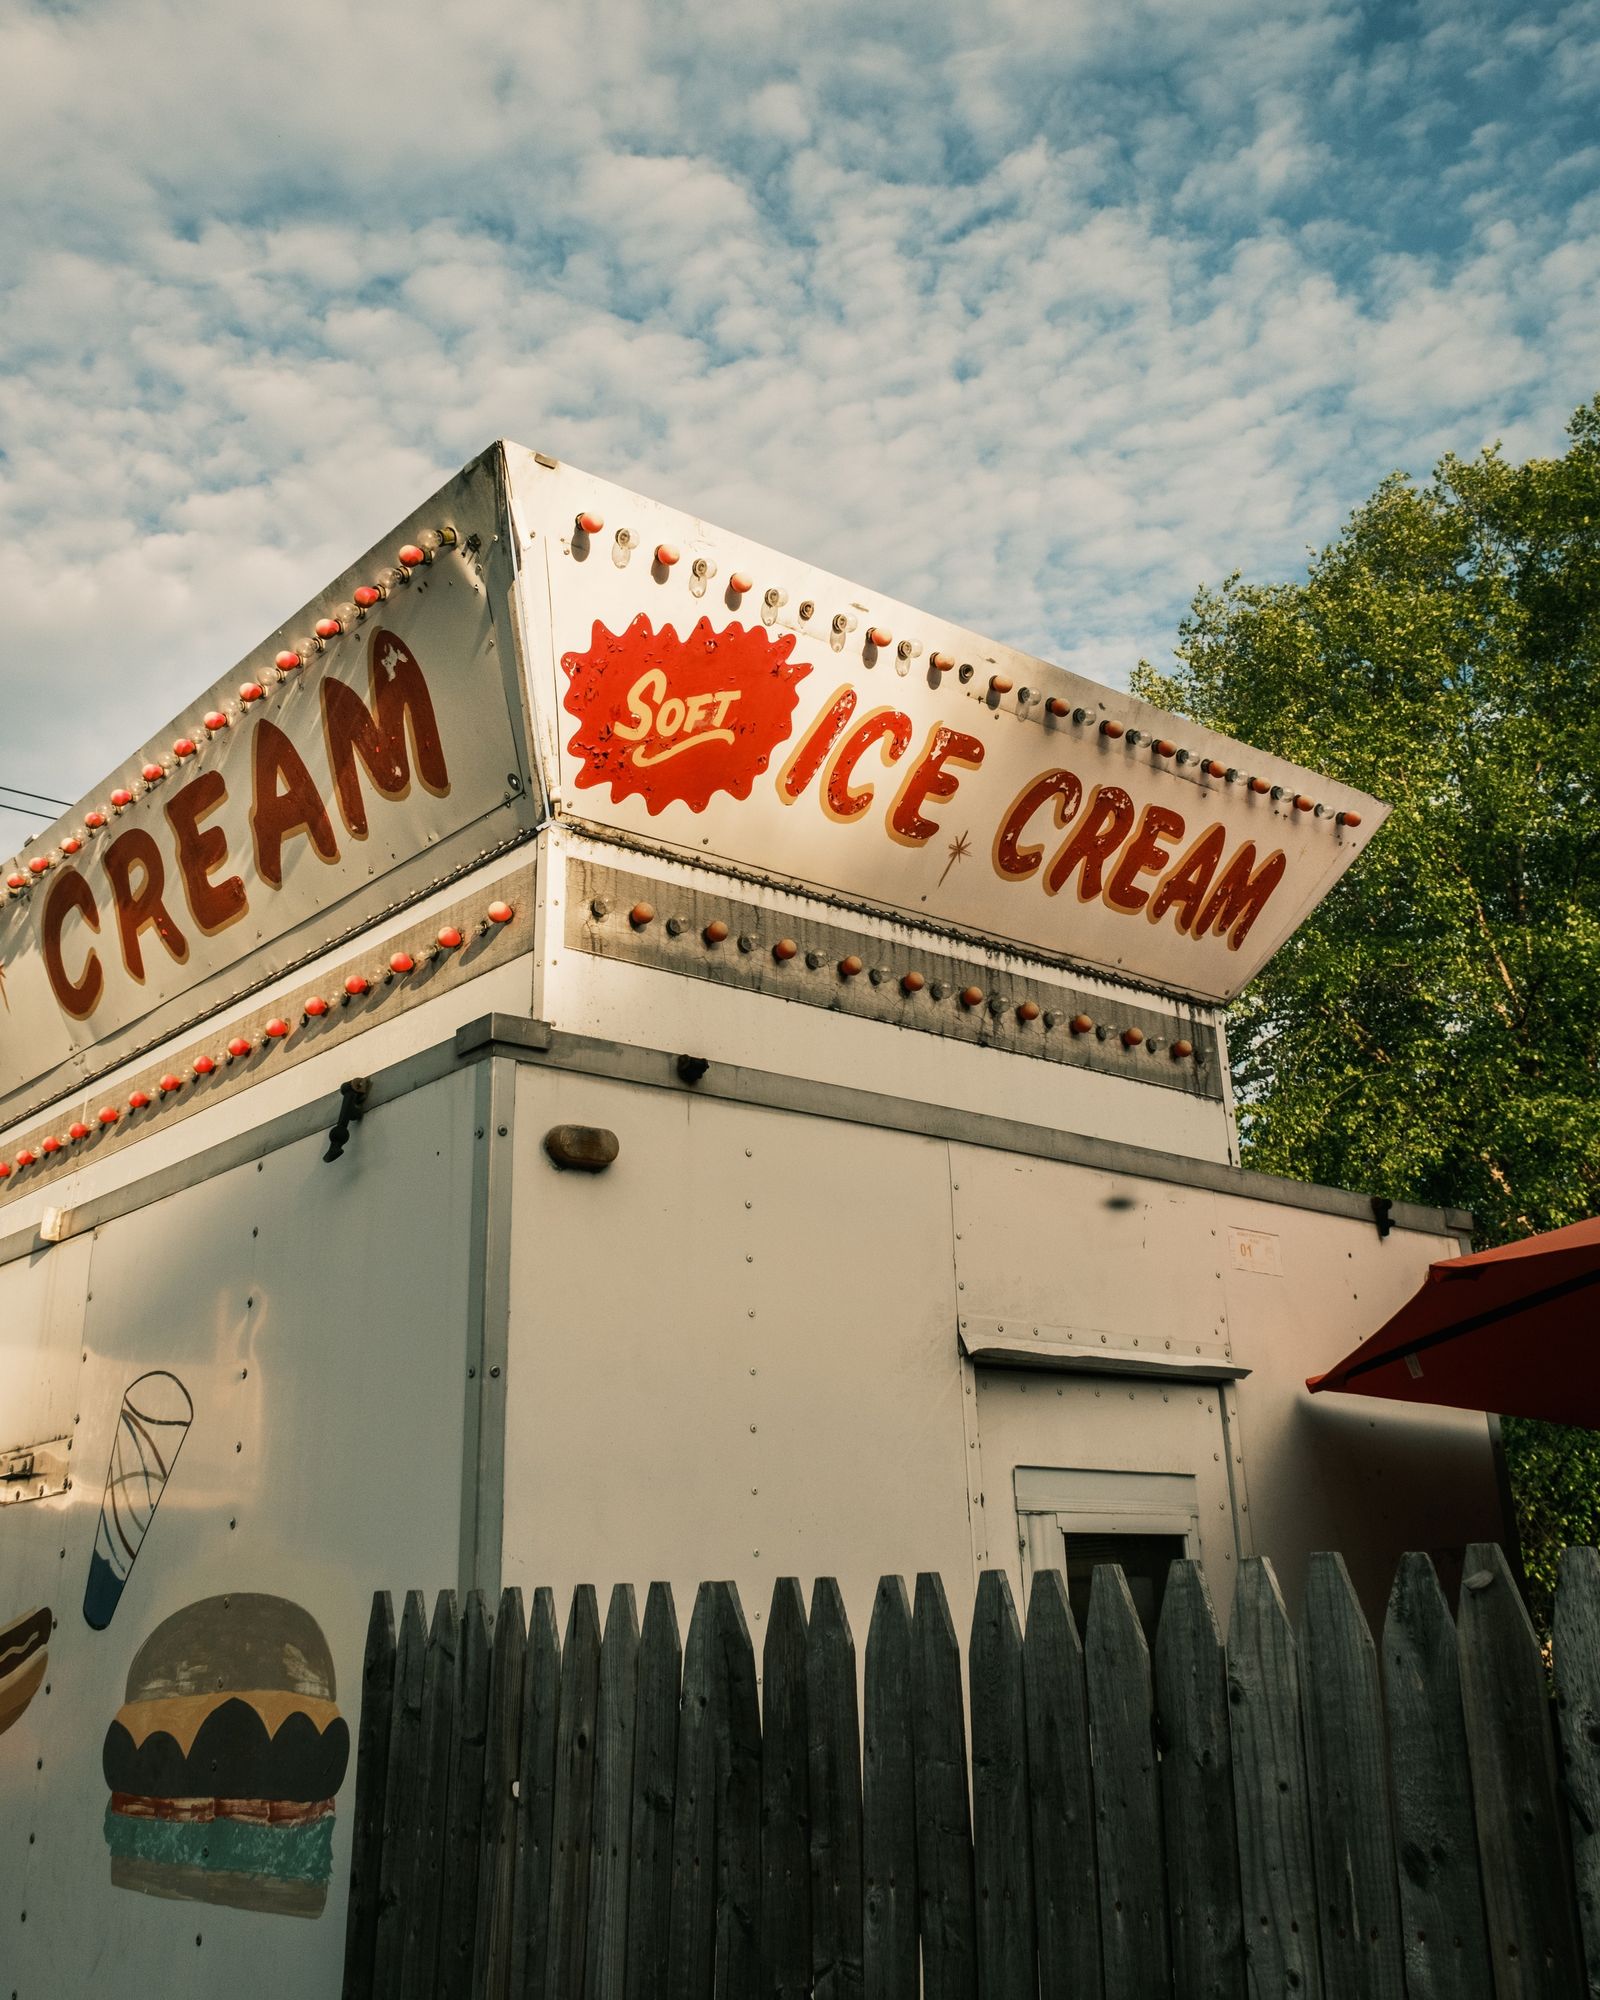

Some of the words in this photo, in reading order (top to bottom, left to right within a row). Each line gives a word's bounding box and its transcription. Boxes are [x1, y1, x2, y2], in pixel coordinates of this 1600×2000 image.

[41, 625, 450, 1021] CREAM
[614, 668, 741, 740] SOFT
[776, 683, 985, 848] ICE
[992, 768, 1286, 951] CREAM
